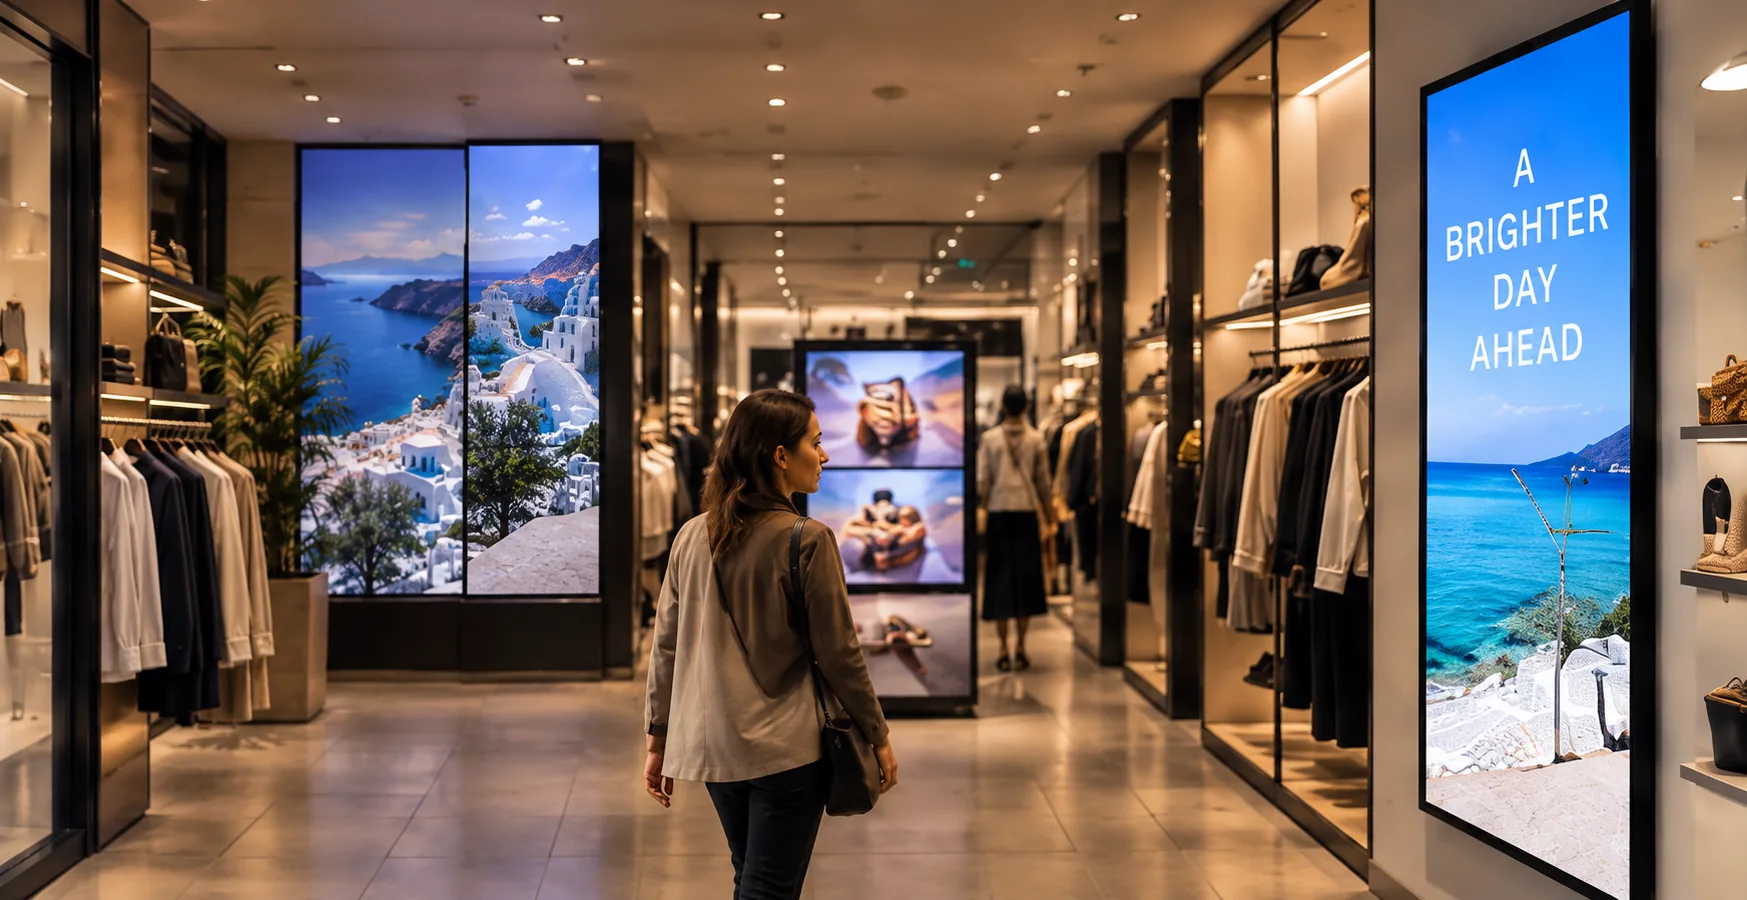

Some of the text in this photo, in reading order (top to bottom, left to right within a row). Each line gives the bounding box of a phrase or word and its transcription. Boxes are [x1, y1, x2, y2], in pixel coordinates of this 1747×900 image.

[1513, 148, 1535, 188] A
[1446, 193, 1609, 262] BRIGHTER
[1493, 263, 1558, 311] DAY
[1469, 322, 1583, 373] AHEAD
